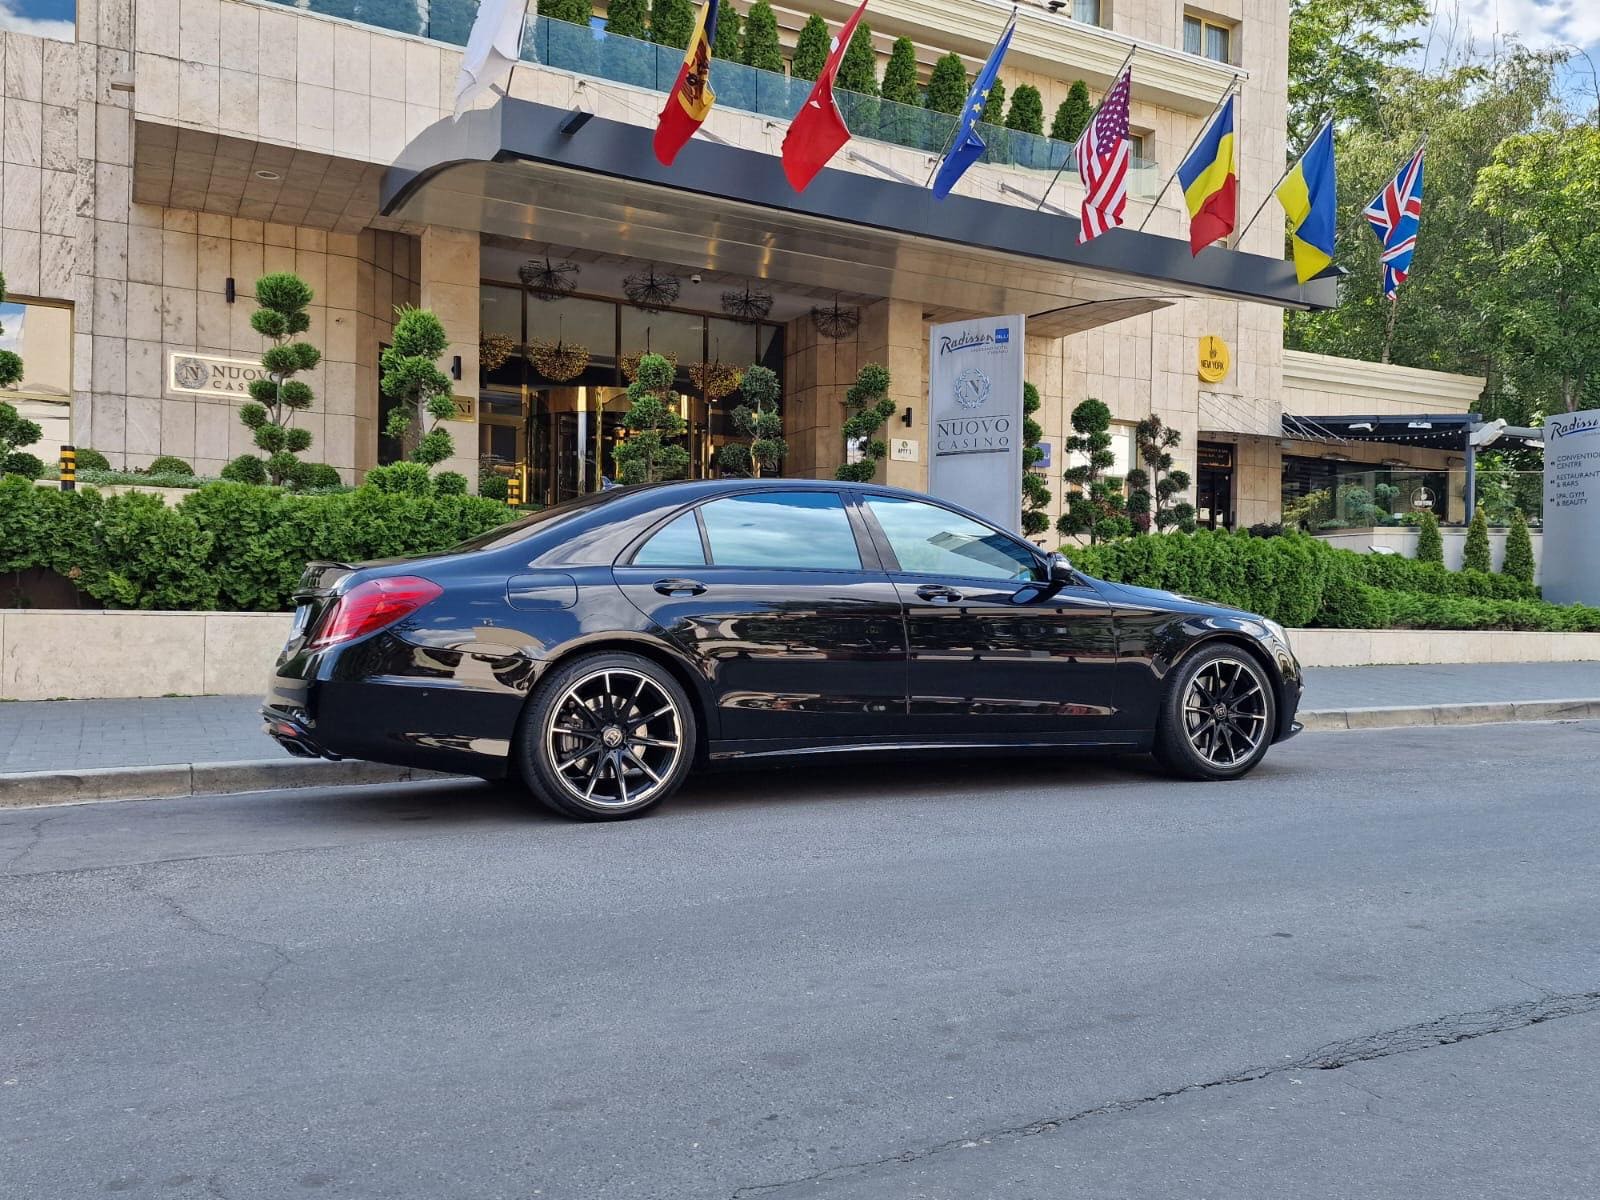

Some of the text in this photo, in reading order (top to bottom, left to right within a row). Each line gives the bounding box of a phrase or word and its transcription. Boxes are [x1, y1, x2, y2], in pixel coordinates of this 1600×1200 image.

[940, 331, 994, 356] Radisson
[185, 366, 199, 380] N
[213, 381, 244, 391] CAS
[936, 418, 1010, 437] NUOVO
[1551, 416, 1600, 440] Radisso
[937, 437, 1009, 450] CASINO
[1556, 461, 1582, 470] CENTRE
[1569, 491, 1585, 499] GYM
[1562, 498, 1588, 507] BEAUTY
